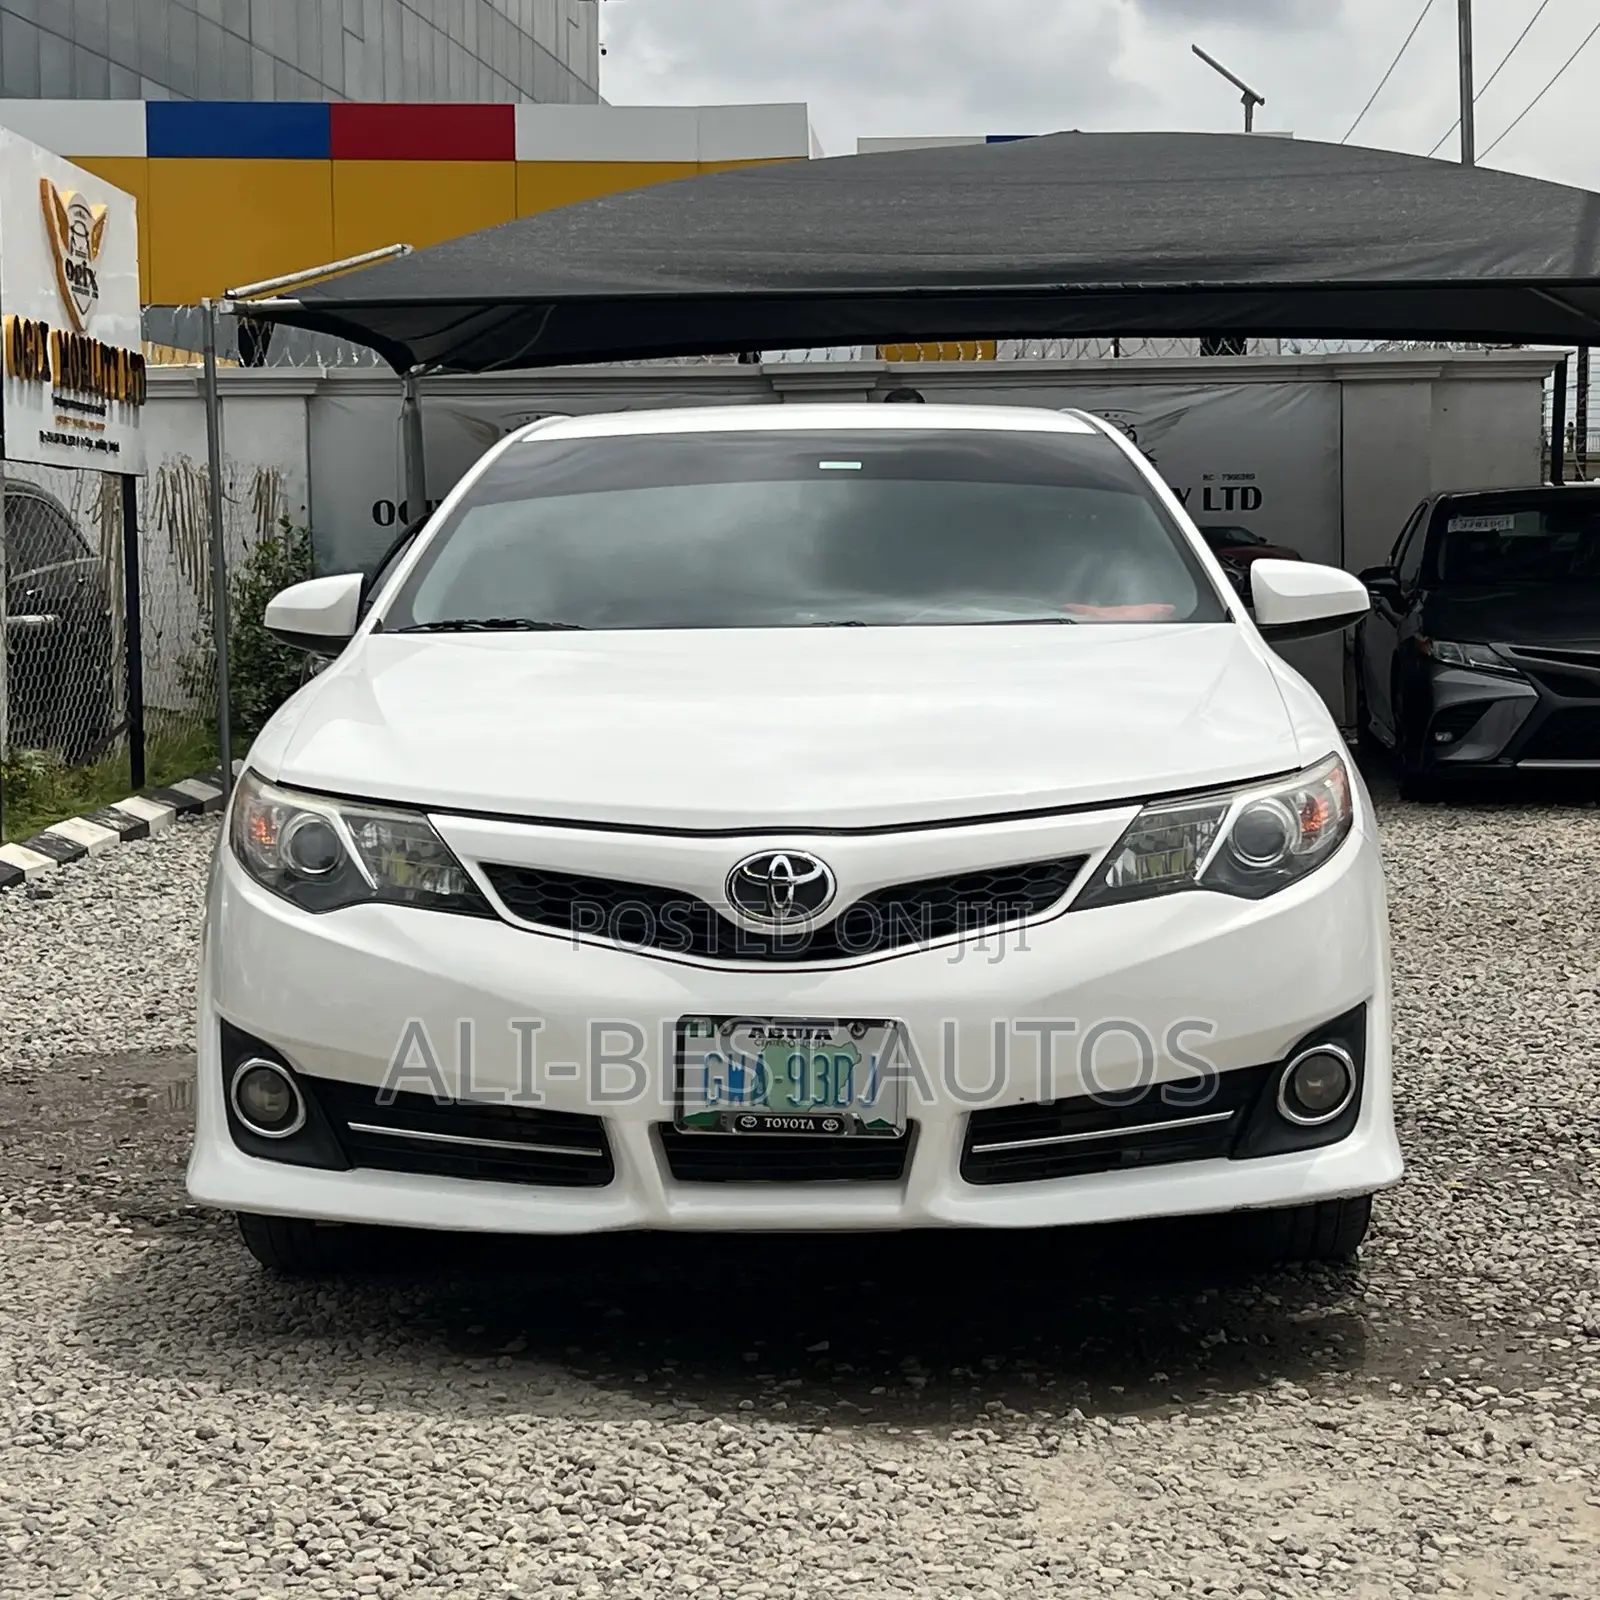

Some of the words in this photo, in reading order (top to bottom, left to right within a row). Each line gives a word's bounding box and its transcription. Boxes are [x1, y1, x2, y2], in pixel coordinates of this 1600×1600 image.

[1203, 486, 1262, 511] LTD
[748, 1026, 833, 1041] ABUJA
[764, 1117, 816, 1130] TOYOTA
